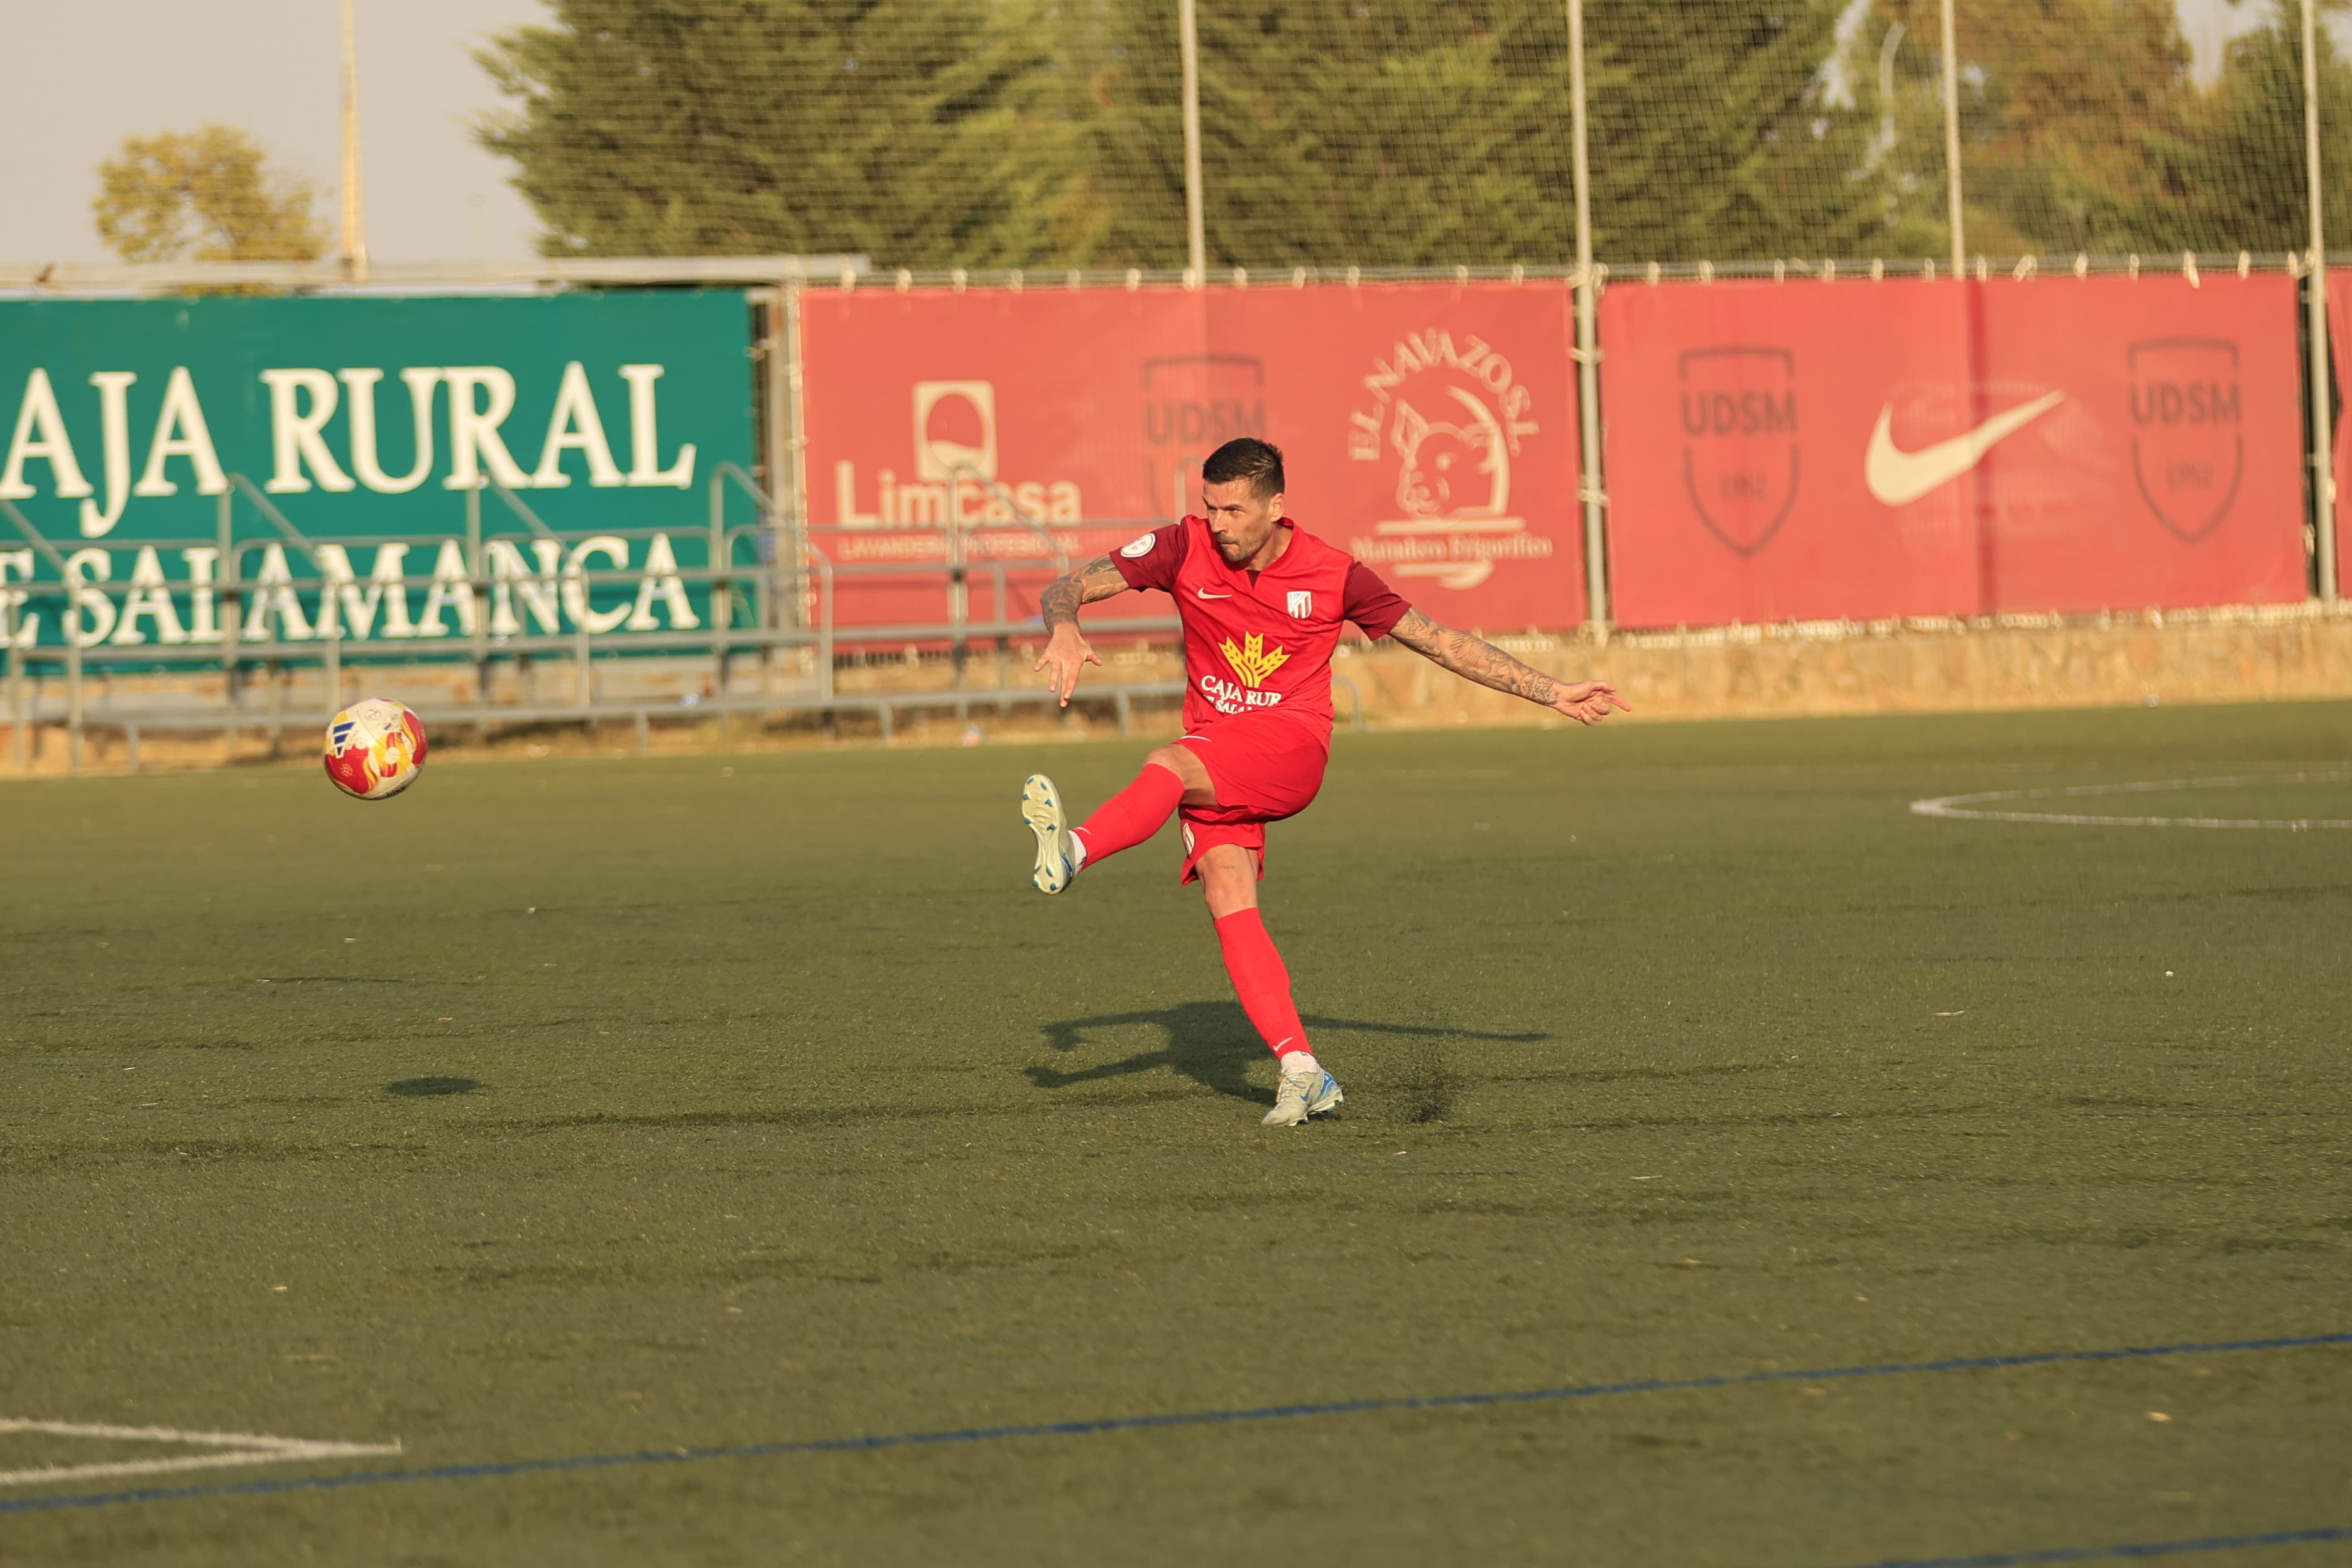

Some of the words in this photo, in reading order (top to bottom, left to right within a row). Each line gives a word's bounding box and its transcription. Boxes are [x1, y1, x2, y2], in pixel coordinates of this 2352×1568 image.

[258, 360, 697, 494] RURAL
[1680, 386, 1798, 436] UDSM
[2127, 378, 2243, 426] UDSM
[835, 459, 1083, 530] Limcasa
[63, 532, 700, 648] SALAMANCA
[1201, 675, 1243, 702] CAJA
